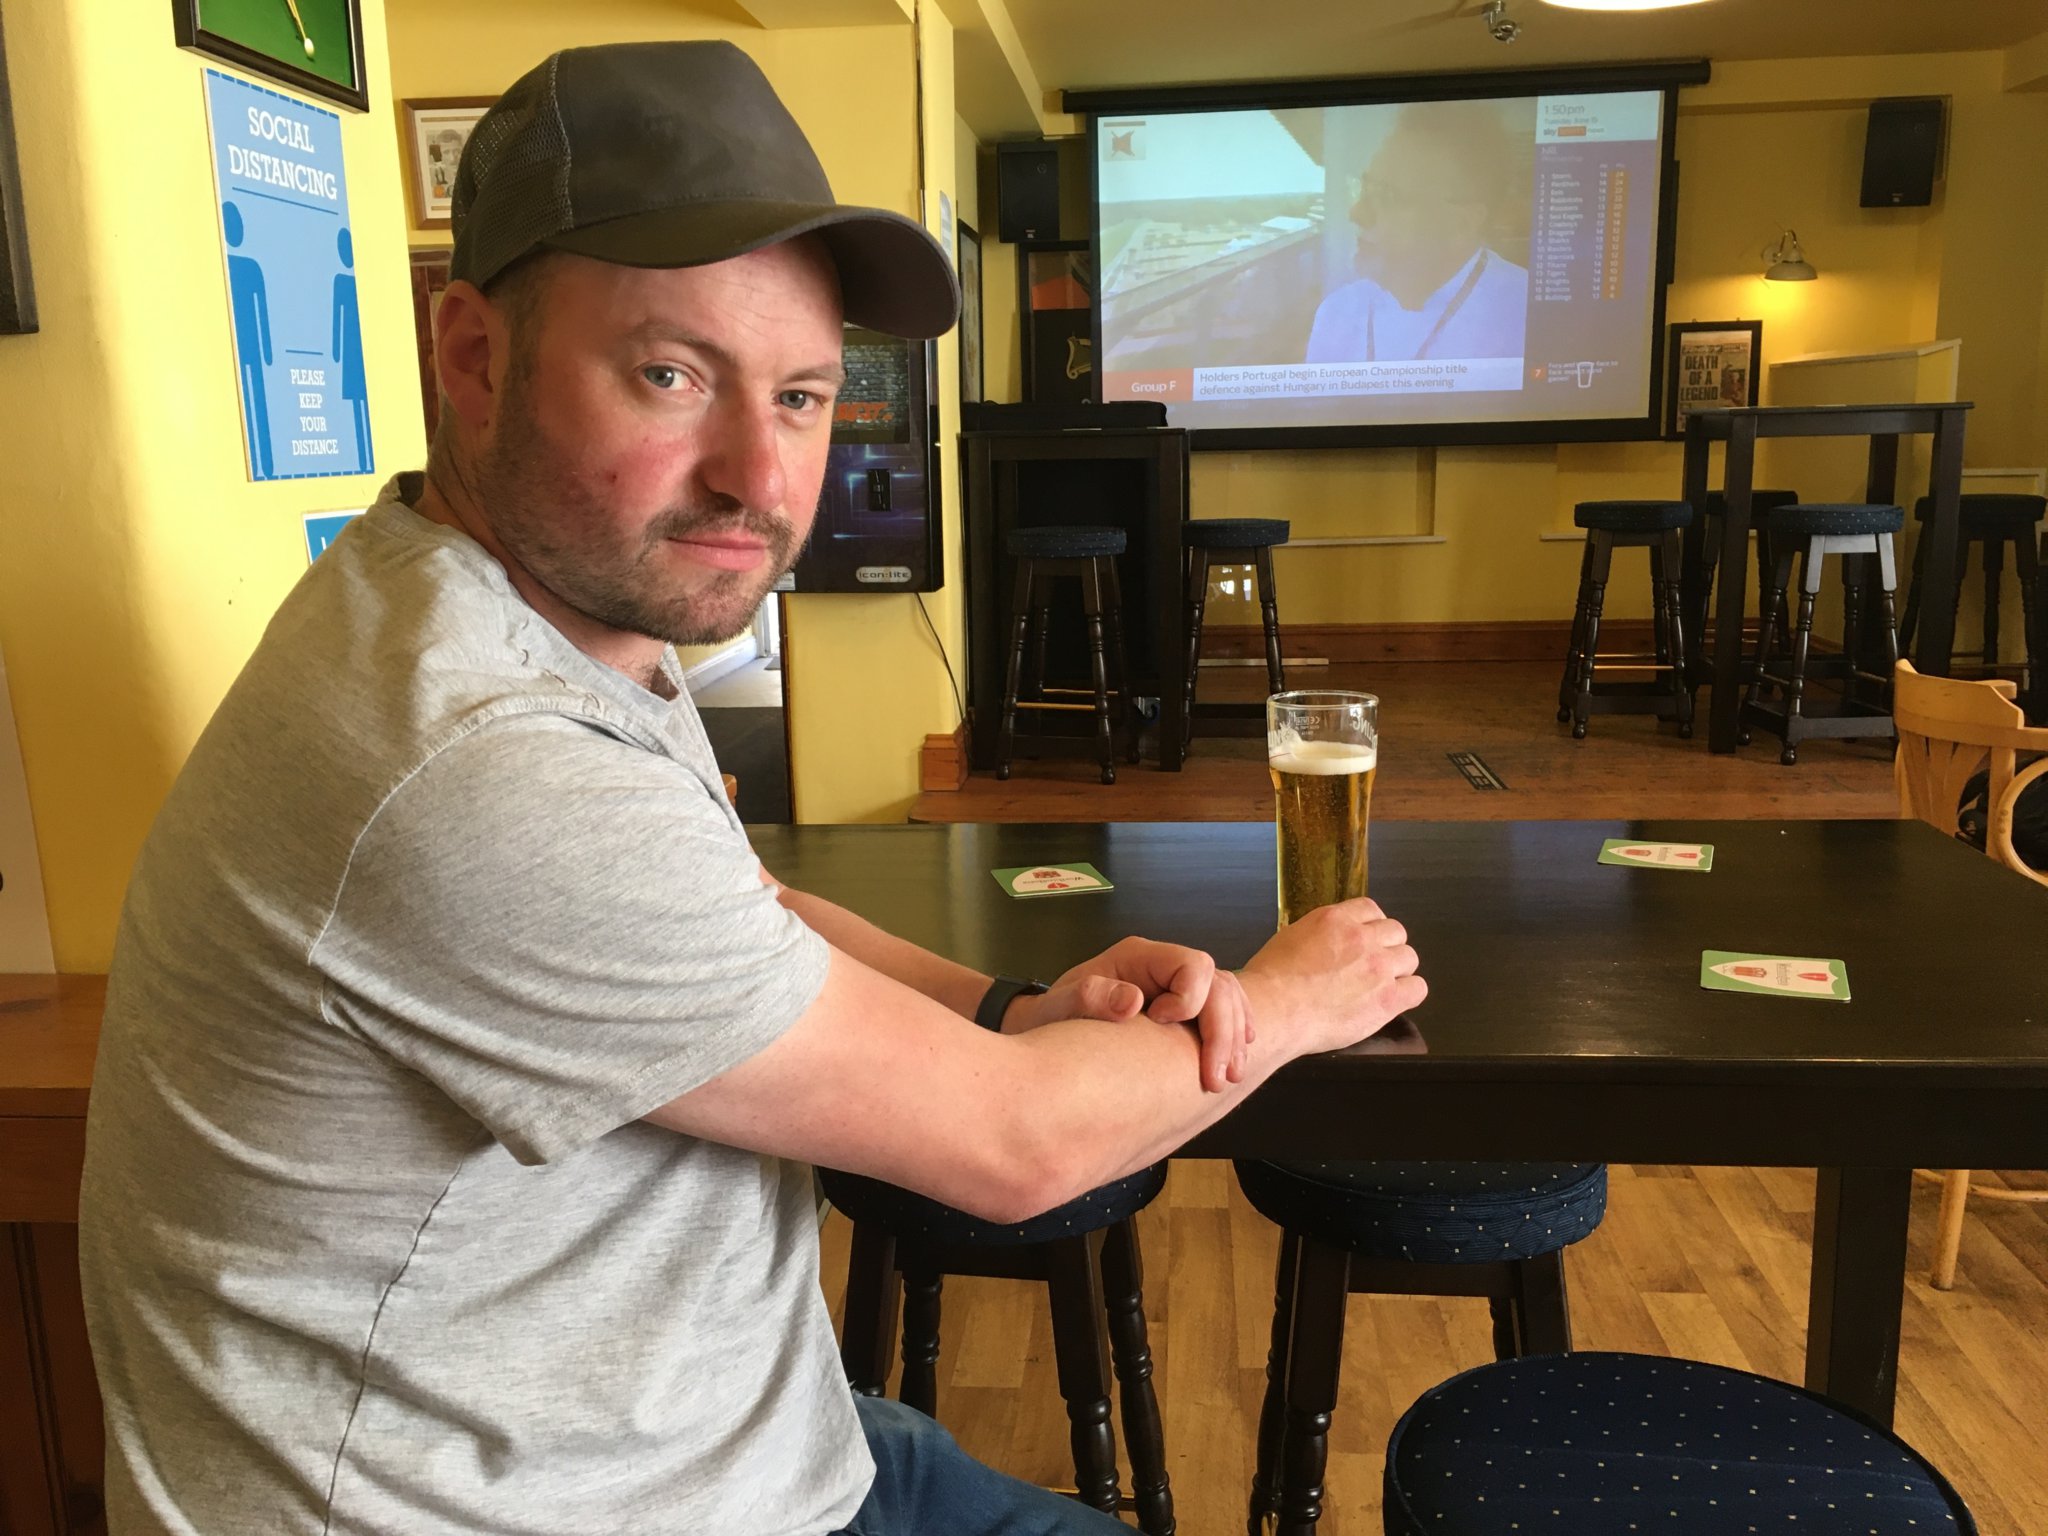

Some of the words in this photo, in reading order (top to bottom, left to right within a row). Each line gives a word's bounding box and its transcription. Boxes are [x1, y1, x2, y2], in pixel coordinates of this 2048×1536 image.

[247, 106, 315, 153] SOCIAL
[227, 144, 338, 200] DISTANCING
[1685, 355, 1718, 370] DEATH
[290, 368, 325, 386] PLEASE
[1200, 373, 1240, 383] Holders
[1242, 371, 1286, 382] Portugal
[1289, 369, 1317, 380] begin
[1320, 367, 1368, 379] European
[1370, 365, 1443, 377] Championship
[1446, 364, 1468, 374] title
[1689, 371, 1702, 385] OF
[1705, 371, 1712, 385] A
[1131, 382, 1167, 393] Group
[1169, 380, 1177, 391] F
[1200, 385, 1241, 395] defence
[1243, 383, 1280, 394] against
[1284, 382, 1326, 393] Hungary
[1329, 380, 1338, 390] in
[1341, 379, 1390, 391] Budapest
[1392, 378, 1412, 388] this
[1415, 378, 1454, 389] evening
[1681, 386, 1719, 401] LEGEND
[299, 392, 323, 409] KEEP
[300, 416, 327, 432] YOUR
[292, 439, 339, 456] DISTANCE
